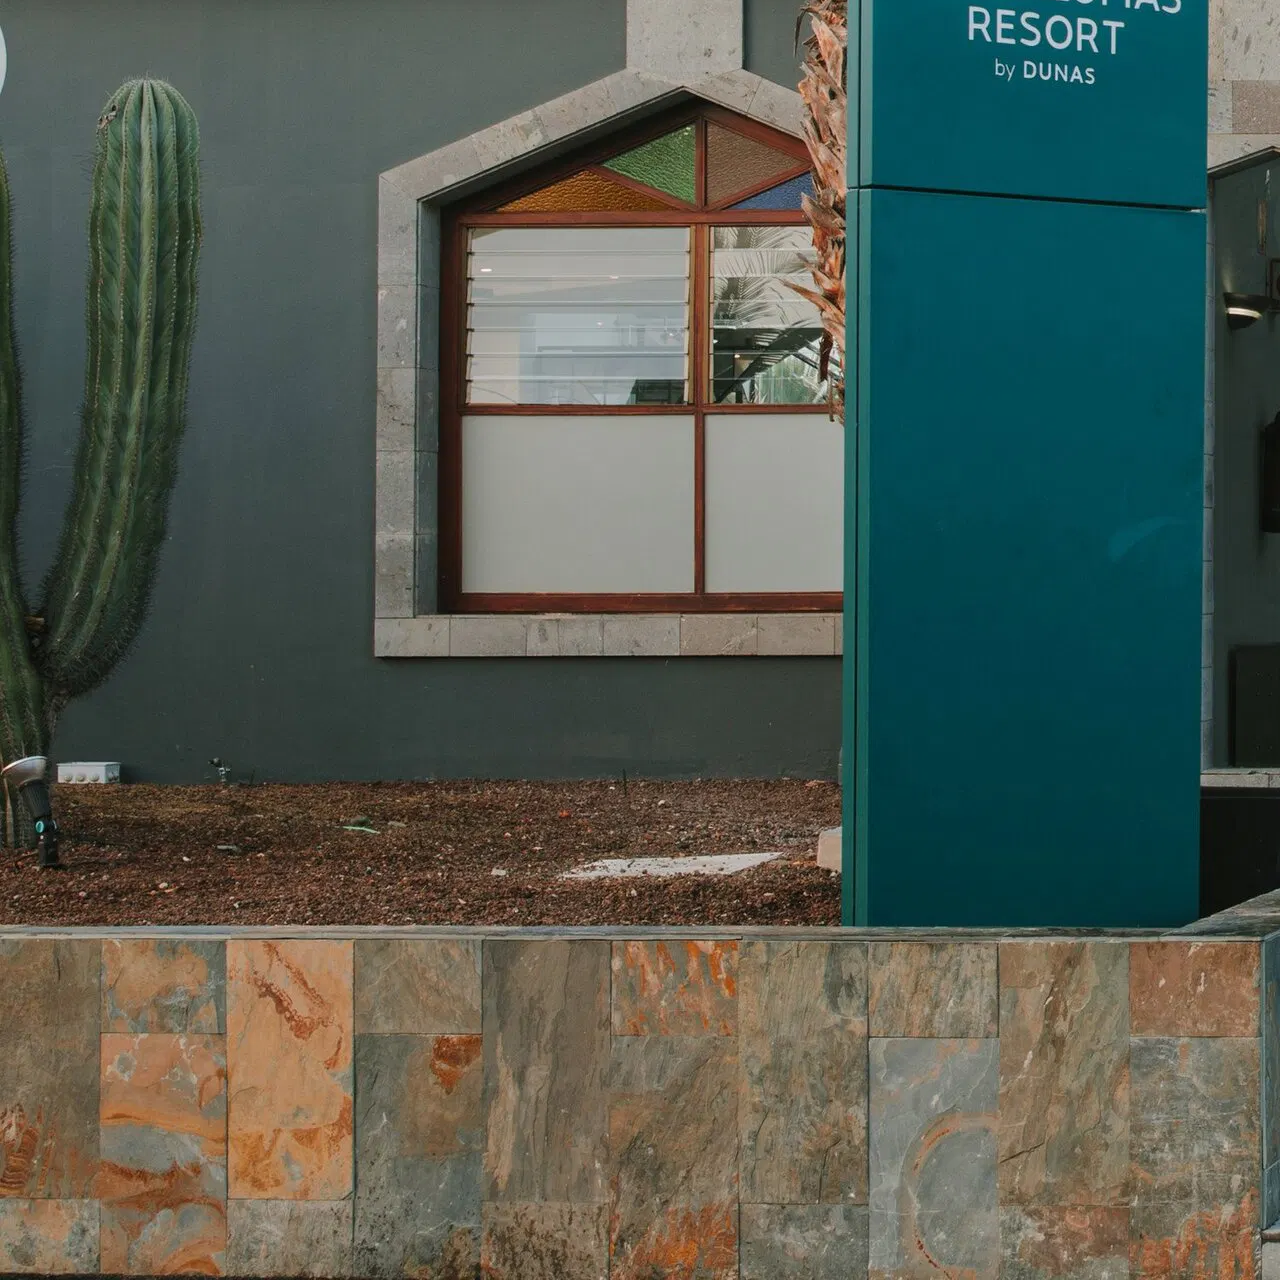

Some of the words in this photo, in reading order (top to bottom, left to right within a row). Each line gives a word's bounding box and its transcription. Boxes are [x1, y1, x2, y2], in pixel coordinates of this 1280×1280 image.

[968, 5, 1125, 55] RESORT
[995, 58, 1016, 81] by
[1023, 60, 1096, 85] DUNAS
